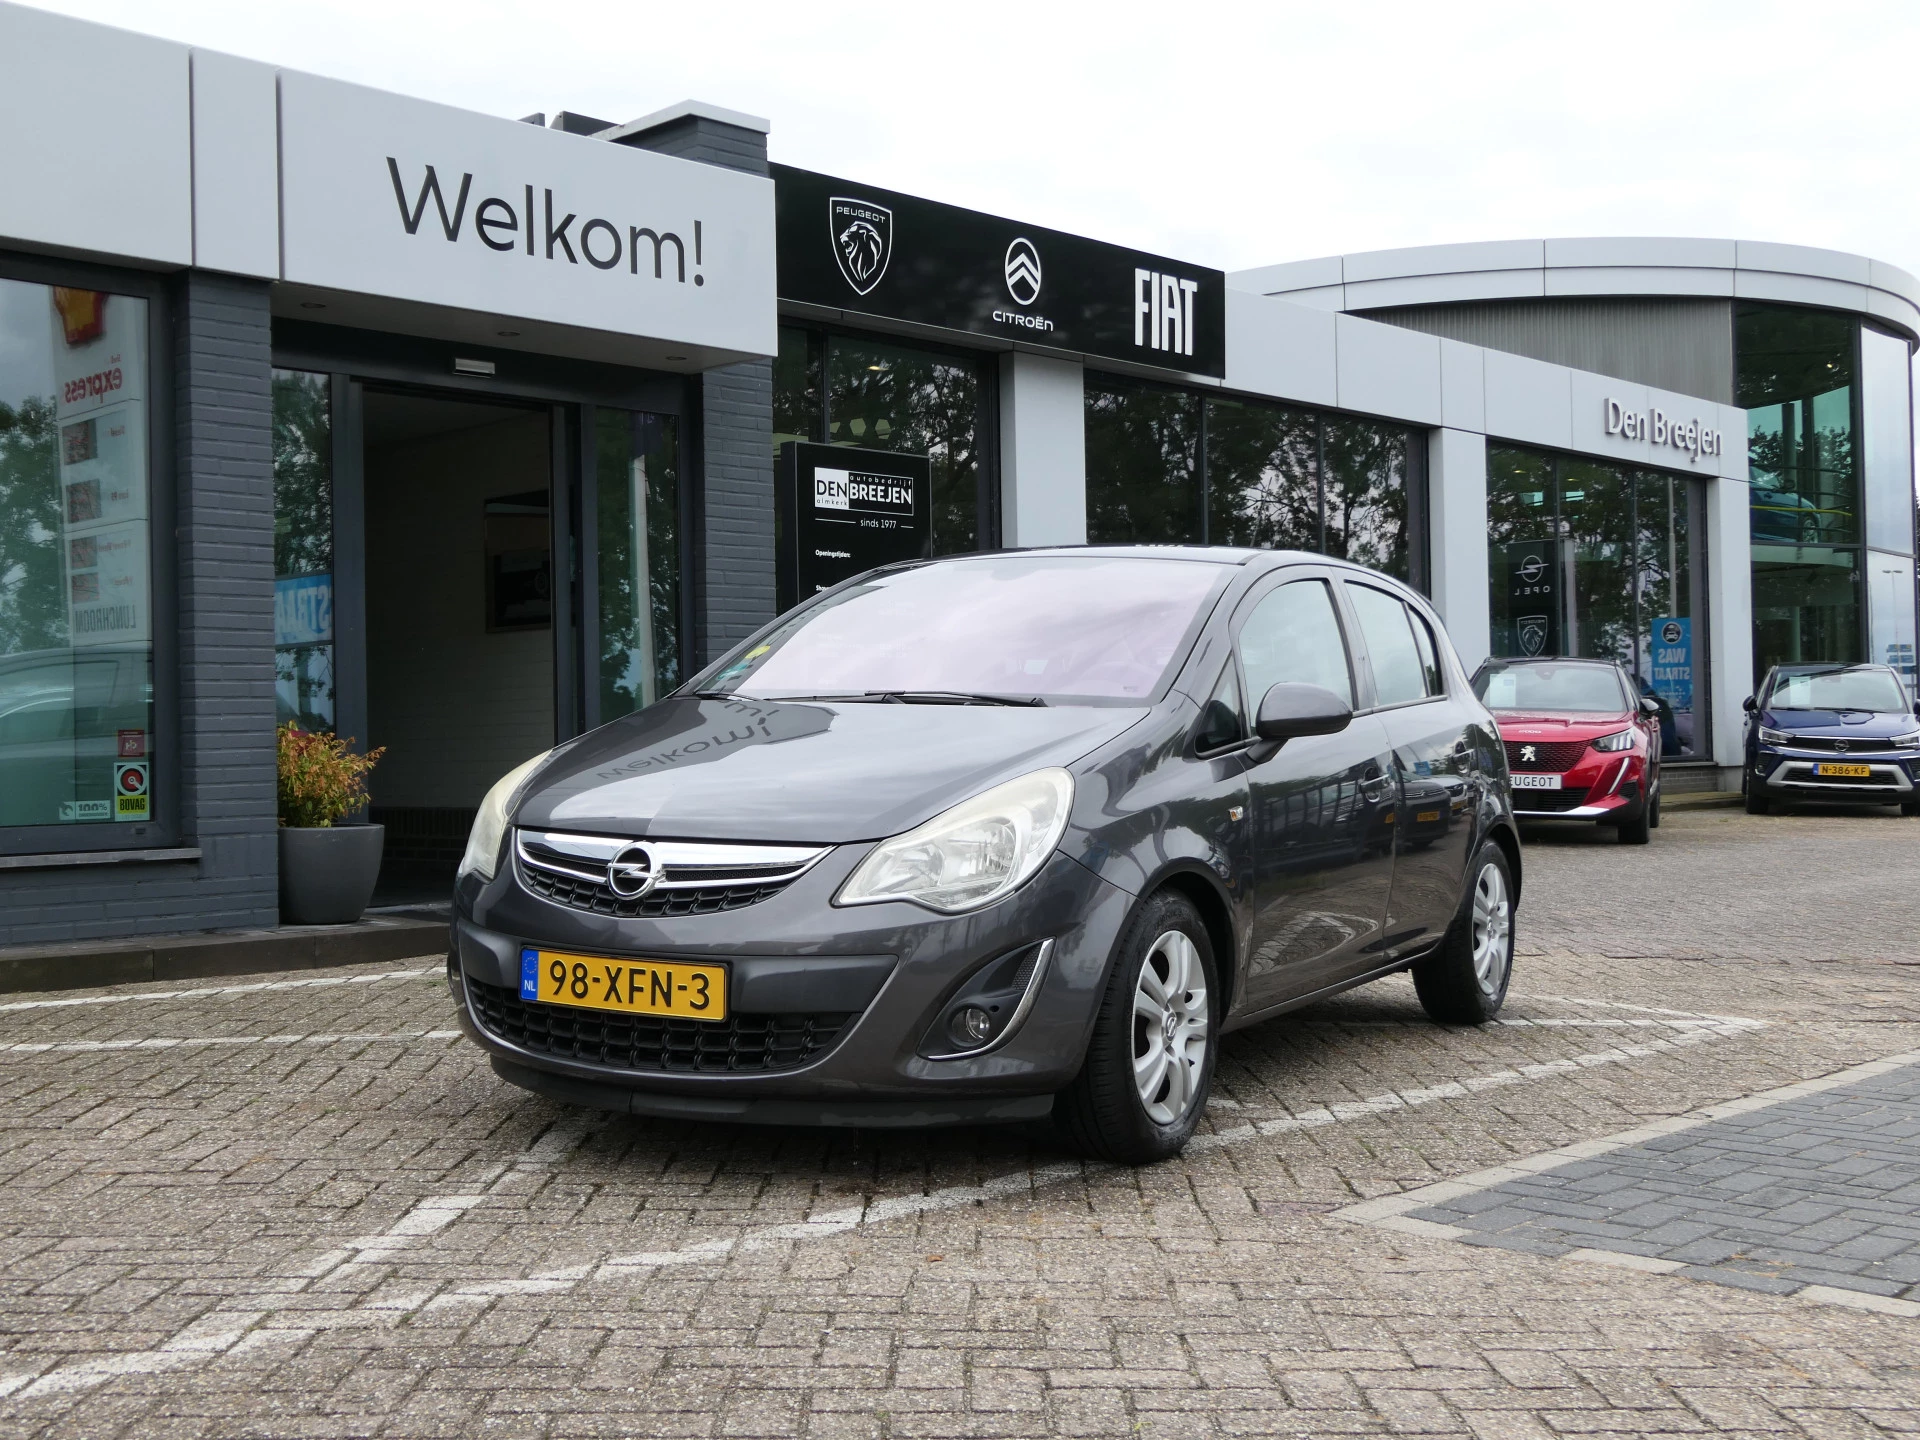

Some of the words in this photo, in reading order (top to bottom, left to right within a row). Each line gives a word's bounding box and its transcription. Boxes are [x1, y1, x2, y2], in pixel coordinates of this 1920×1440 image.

[386, 156, 704, 287] Welkom!
[836, 206, 886, 223] PEUGEOT
[1134, 267, 1198, 356] FIAT
[1604, 398, 1648, 441] Den
[1650, 408, 1723, 463] Breejen
[816, 479, 847, 498] DEN
[850, 475, 912, 487] autobedrijf
[849, 483, 912, 505] BREEJEN
[816, 498, 848, 507] almkerk
[860, 518, 879, 528] sinds
[880, 519, 897, 529] 1977
[1821, 765, 1867, 775] N-386-KF
[78, 802, 108, 812] 100%
[120, 798, 145, 811] BOVAG
[524, 979, 537, 992] NL
[549, 959, 710, 1011] 98-XFN-3
